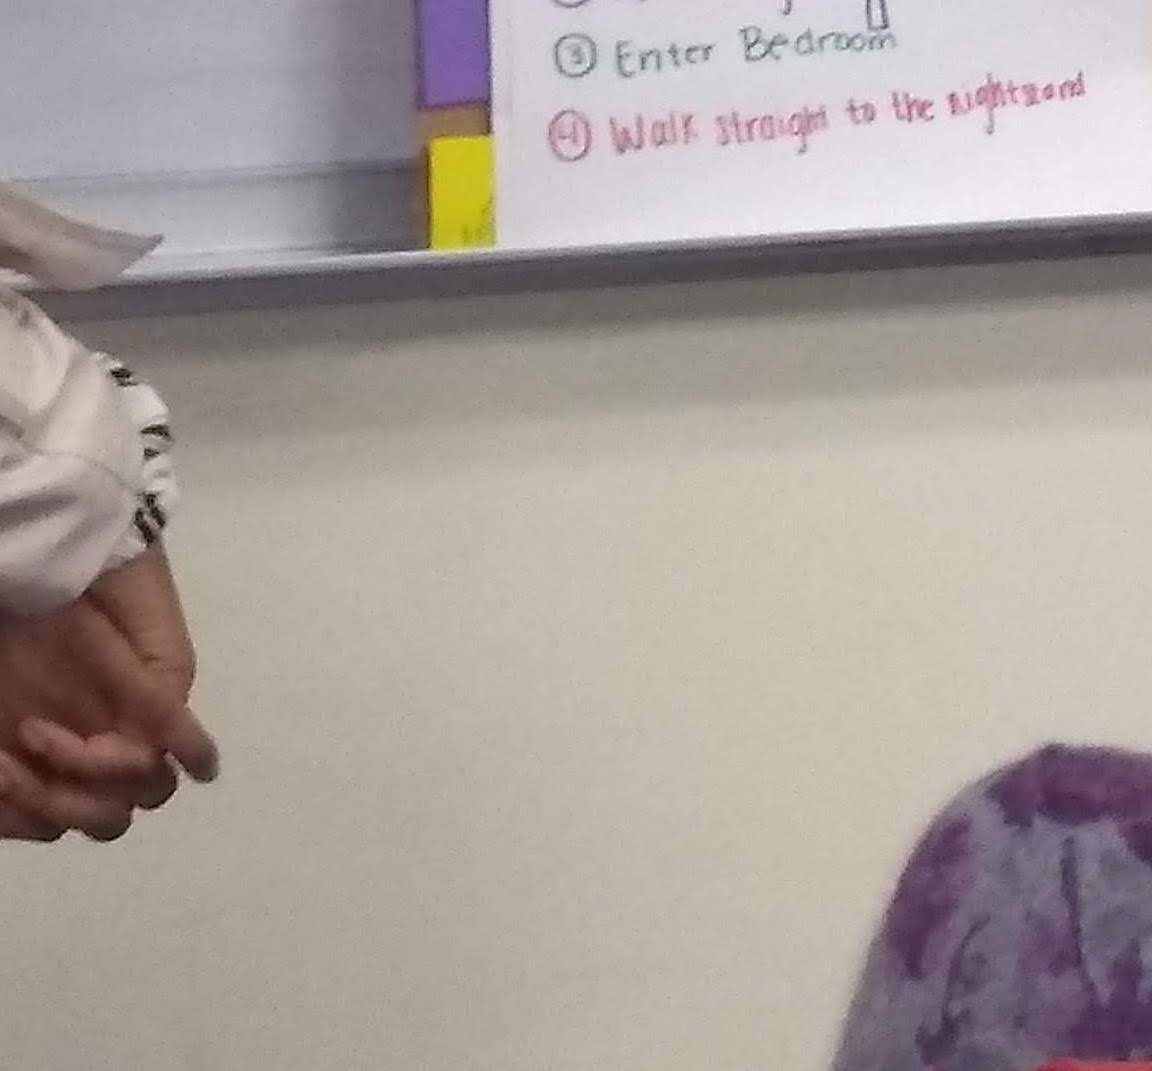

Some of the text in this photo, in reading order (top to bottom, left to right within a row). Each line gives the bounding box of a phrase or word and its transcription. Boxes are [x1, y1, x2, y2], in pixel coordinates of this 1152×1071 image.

[614, 39, 717, 79] Enter
[738, 24, 898, 63] Bedroom
[608, 112, 696, 155] Walk
[845, 98, 878, 125] to
[890, 89, 935, 124] the
